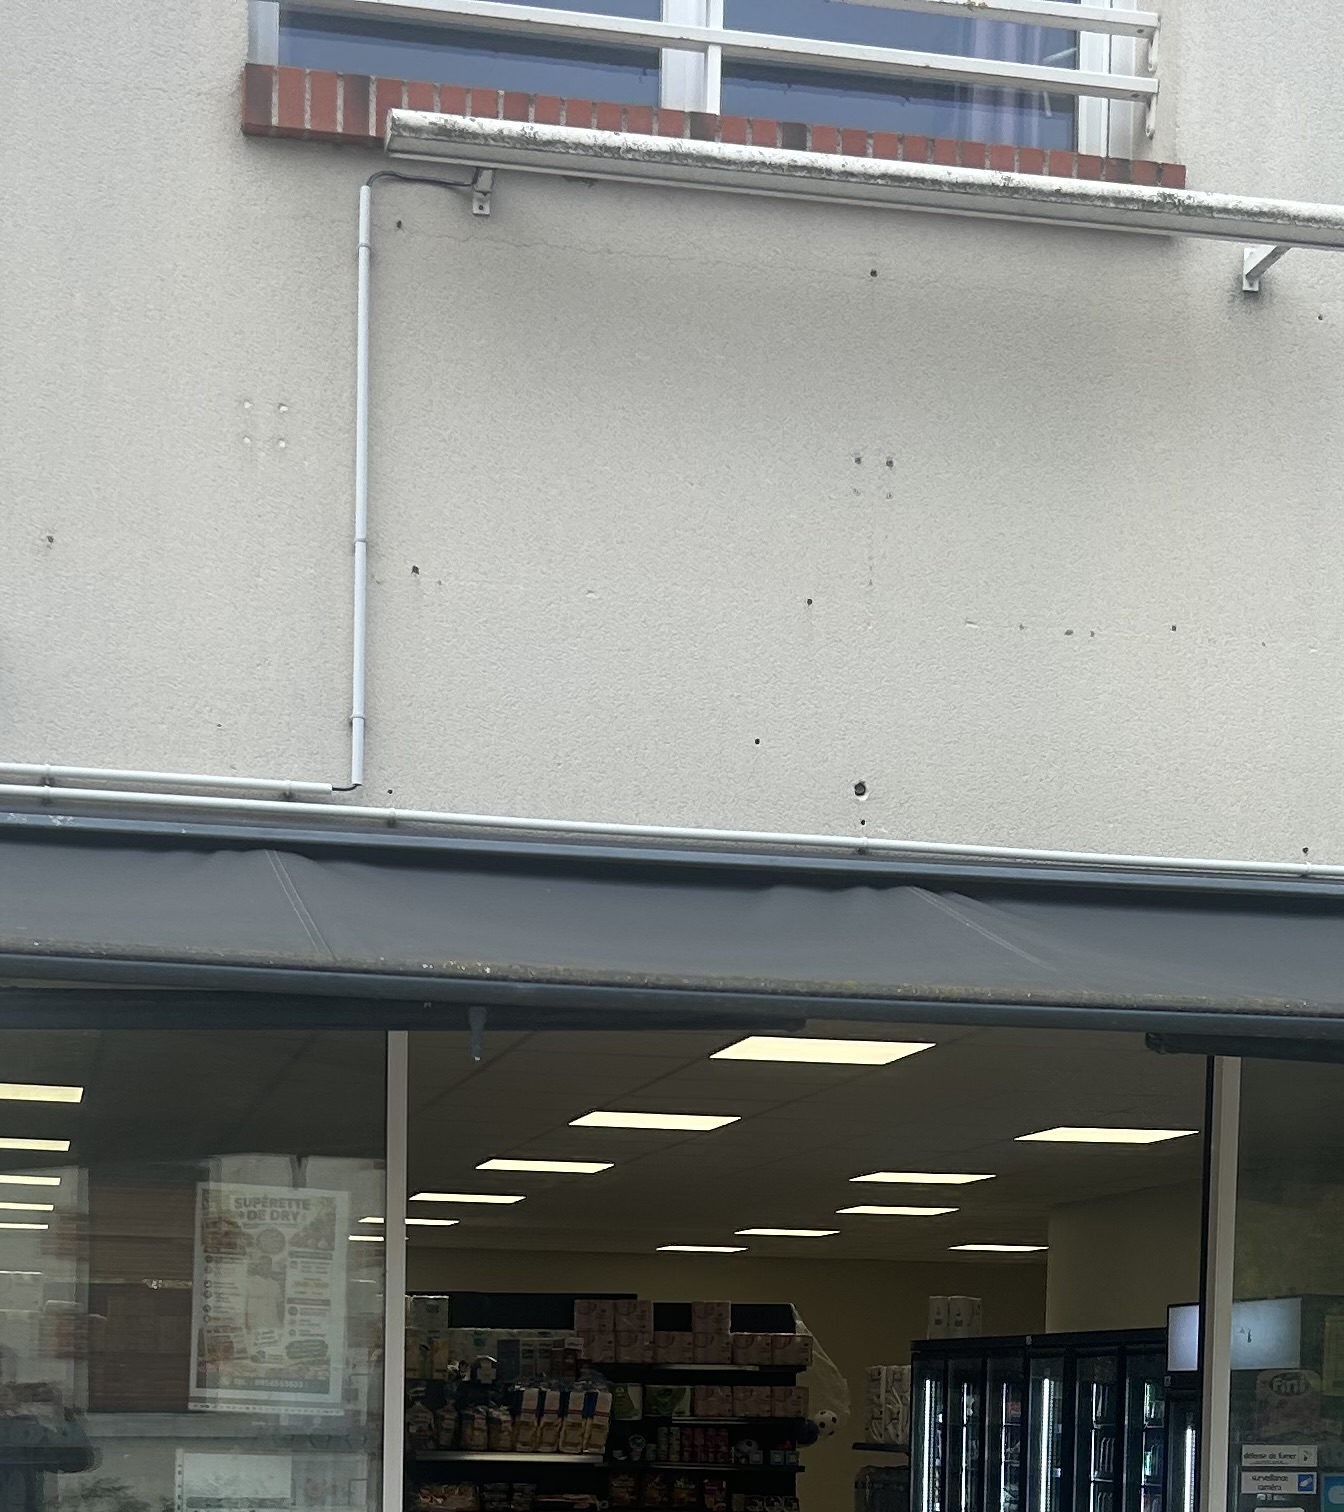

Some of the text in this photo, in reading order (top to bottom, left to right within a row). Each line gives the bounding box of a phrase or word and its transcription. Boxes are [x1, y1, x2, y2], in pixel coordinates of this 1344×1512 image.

[234, 1195, 311, 1211] SUPÉRETTE
[247, 1210, 301, 1222] DE DRY
